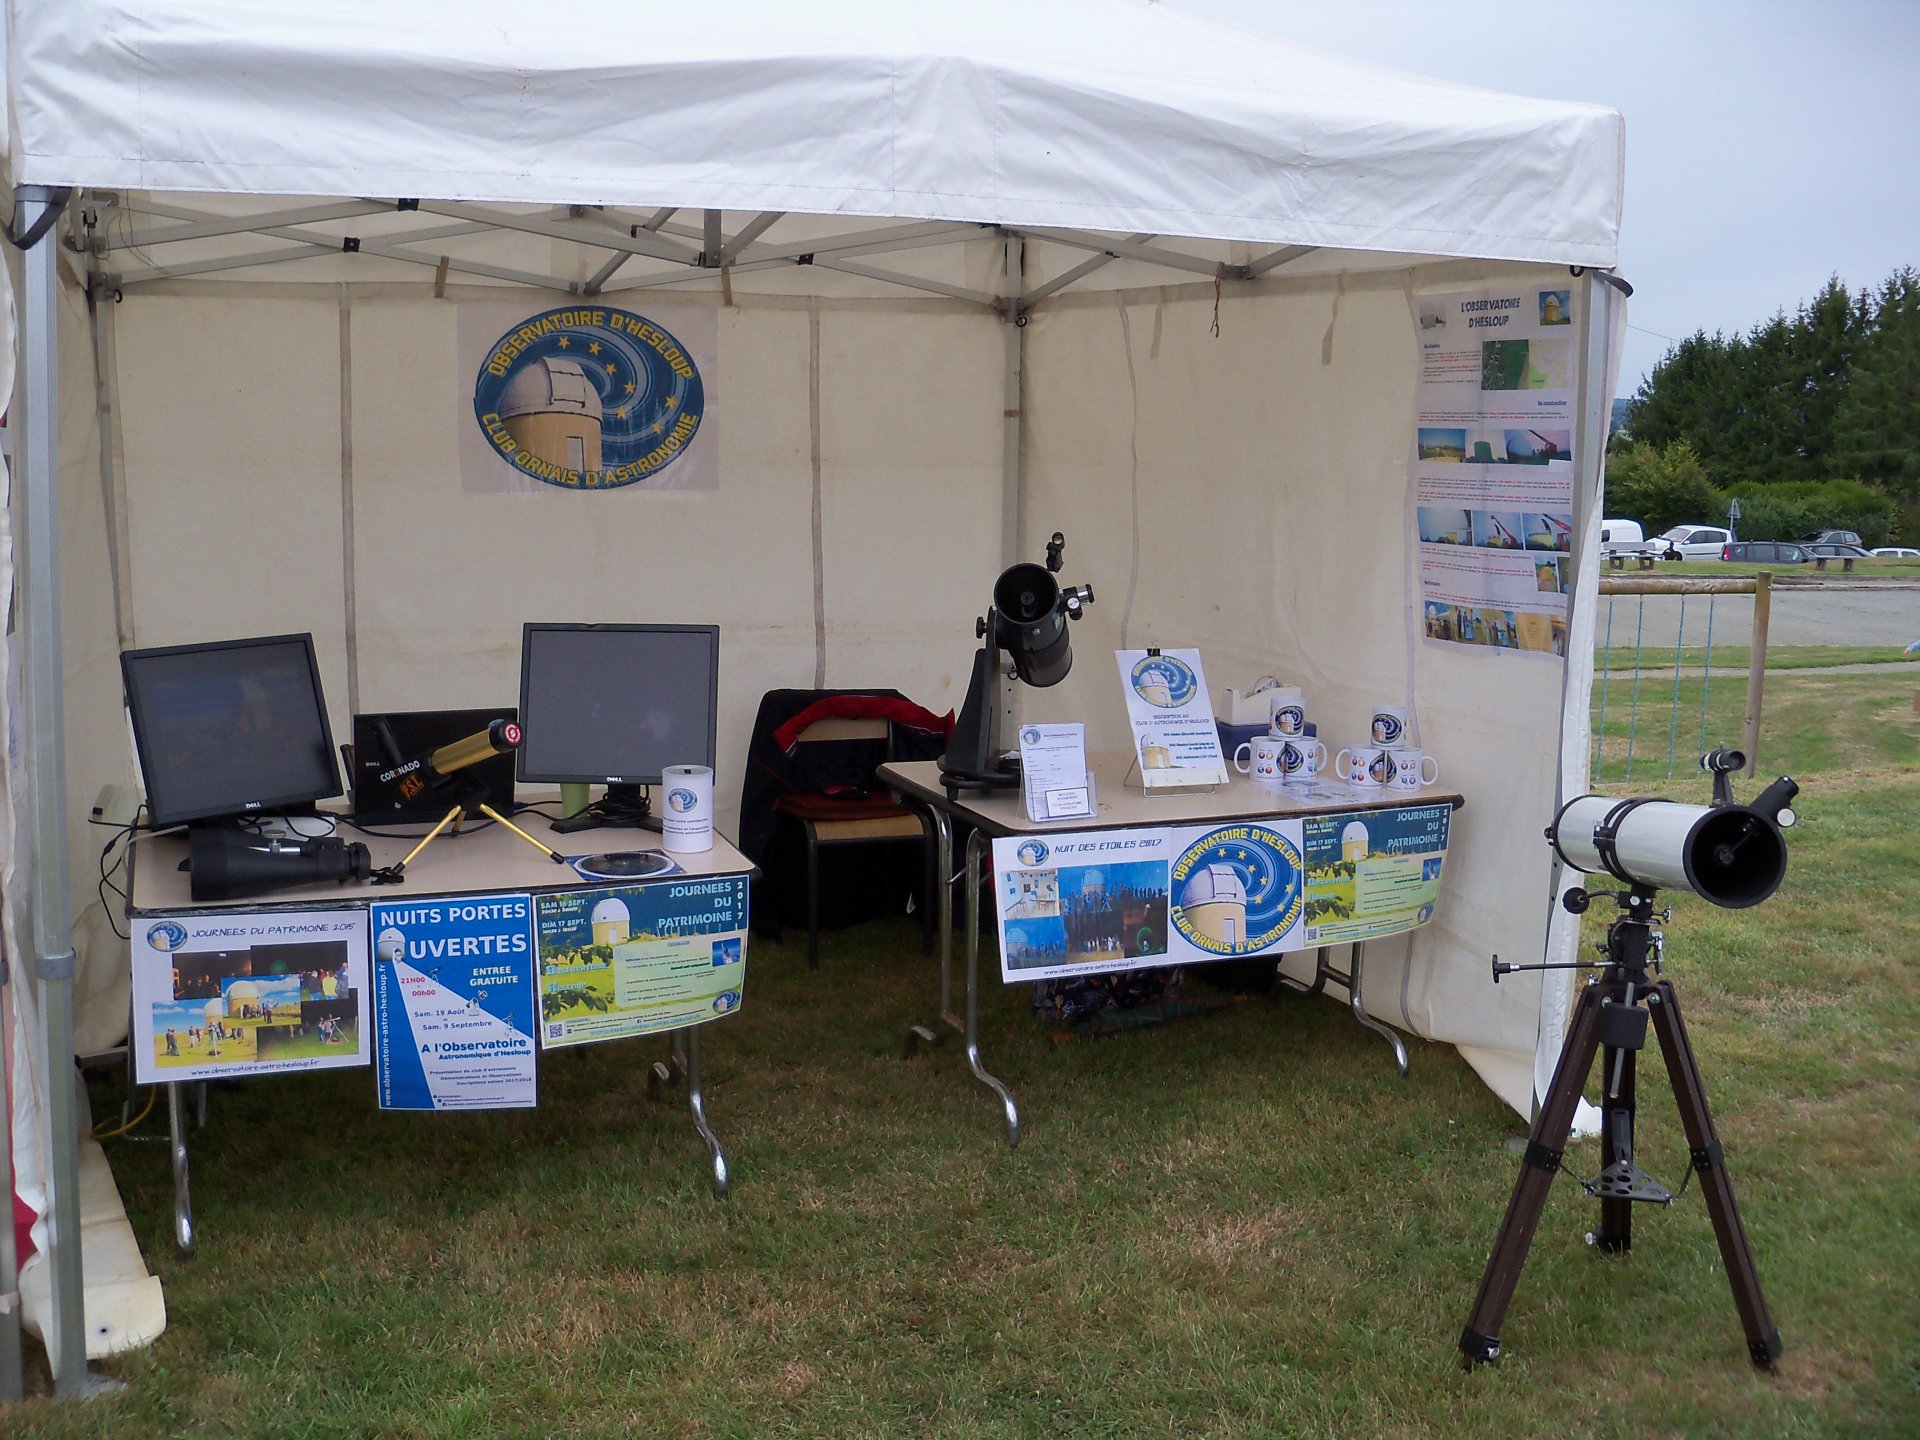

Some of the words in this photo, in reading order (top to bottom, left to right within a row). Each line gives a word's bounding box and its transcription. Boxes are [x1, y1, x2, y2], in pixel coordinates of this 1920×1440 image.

[1461, 297, 1520, 313] L'OBSERVATOIRE
[1468, 315, 1509, 329] D'HESLOUP
[488, 311, 605, 377] OBSERVATOIRE
[610, 312, 694, 379] D'HESLOUP
[482, 412, 519, 453] CLUB
[515, 450, 579, 486] ORNAIS
[585, 413, 697, 486] D'ASTRONOMIE
[380, 760, 421, 783] CORONADO
[245, 801, 262, 809] DELL
[1396, 809, 1440, 822] JOURNEES
[1427, 823, 1439, 832] DU
[1054, 844, 1076, 854] NUIT
[1078, 842, 1096, 852] DES
[1099, 840, 1136, 851] ETOILES
[1139, 838, 1163, 848] 2017
[1388, 834, 1438, 848] PATRIMOINE
[1173, 828, 1249, 881] OBSERVATOIRE
[1251, 829, 1302, 872] D'HESLOUP
[669, 881, 732, 898] JOURNEES
[541, 901, 557, 909] SAM
[568, 898, 588, 907] SEPT.
[714, 897, 732, 908] DU
[380, 908, 442, 926] NUITS
[448, 902, 526, 923] PORTES
[658, 911, 732, 930] PATRIMOINE
[191, 926, 246, 938] JOURNEES
[251, 926, 264, 935] DU
[268, 923, 329, 935] PATRIMOINE
[333, 922, 356, 932] 2015
[542, 921, 557, 929] DIM
[567, 918, 587, 926] SEPT.
[1171, 905, 1192, 934] CLUB
[1190, 930, 1233, 954] ORNAIS
[1235, 895, 1302, 953] D'ASTRONOMIE
[409, 933, 527, 959] UVERTES
[473, 966, 512, 977] ENTREE
[400, 976, 426, 985] 21H00
[469, 975, 519, 987] GRATUITE
[412, 989, 436, 997] 00h00
[414, 1010, 434, 1018] Sam.
[435, 1009, 446, 1017] 19
[447, 1007, 465, 1016] Août
[422, 1023, 442, 1031] Sam.
[443, 1022, 449, 1030] 9
[451, 1019, 493, 1030] Septembre
[379, 963, 393, 1106] www.observatoire-astro-hesloup.fr
[421, 1043, 431, 1054] A
[434, 1038, 527, 1053] l'Observatoire
[438, 1051, 492, 1061] Astronomique
[494, 1048, 532, 1058] d'Hesloup
